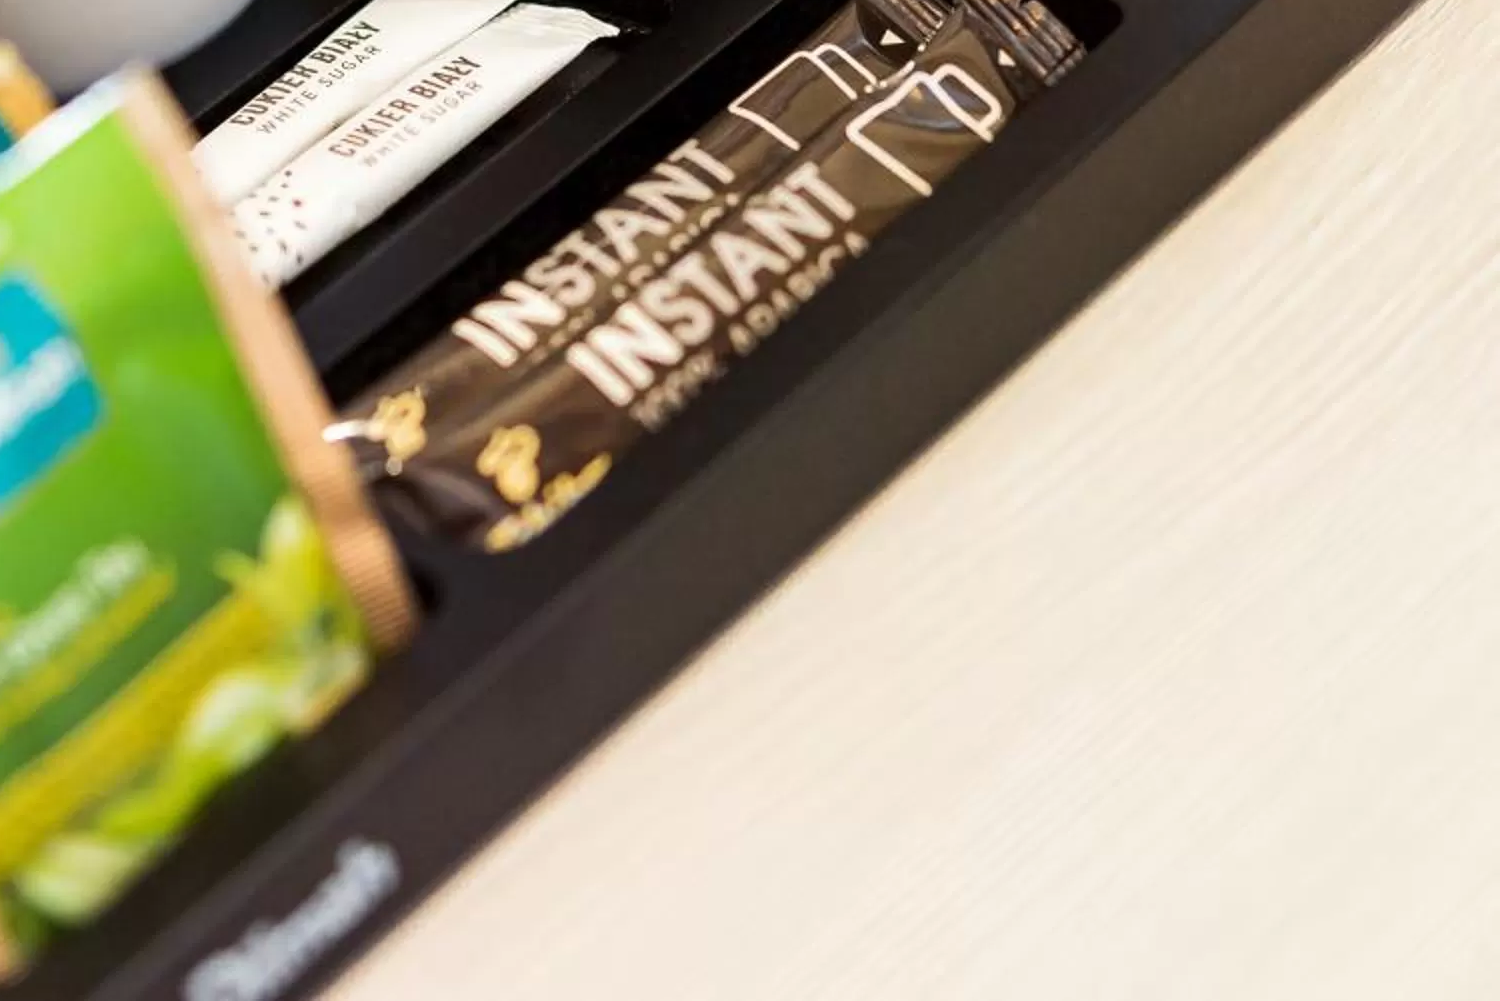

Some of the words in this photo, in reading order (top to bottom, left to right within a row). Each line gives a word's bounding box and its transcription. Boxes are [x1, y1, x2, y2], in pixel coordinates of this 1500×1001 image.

[230, 63, 318, 126] CUKIER
[309, 20, 381, 64] BIAŁY
[256, 90, 318, 134] WHITE
[318, 44, 381, 88] SUGAR
[328, 98, 420, 157] CUKIER
[407, 55, 482, 100] BIAŁY
[360, 125, 420, 167] WHITE
[419, 79, 483, 123] SUGAR
[452, 138, 736, 369] INSTANT
[565, 160, 857, 408] INSTANT
